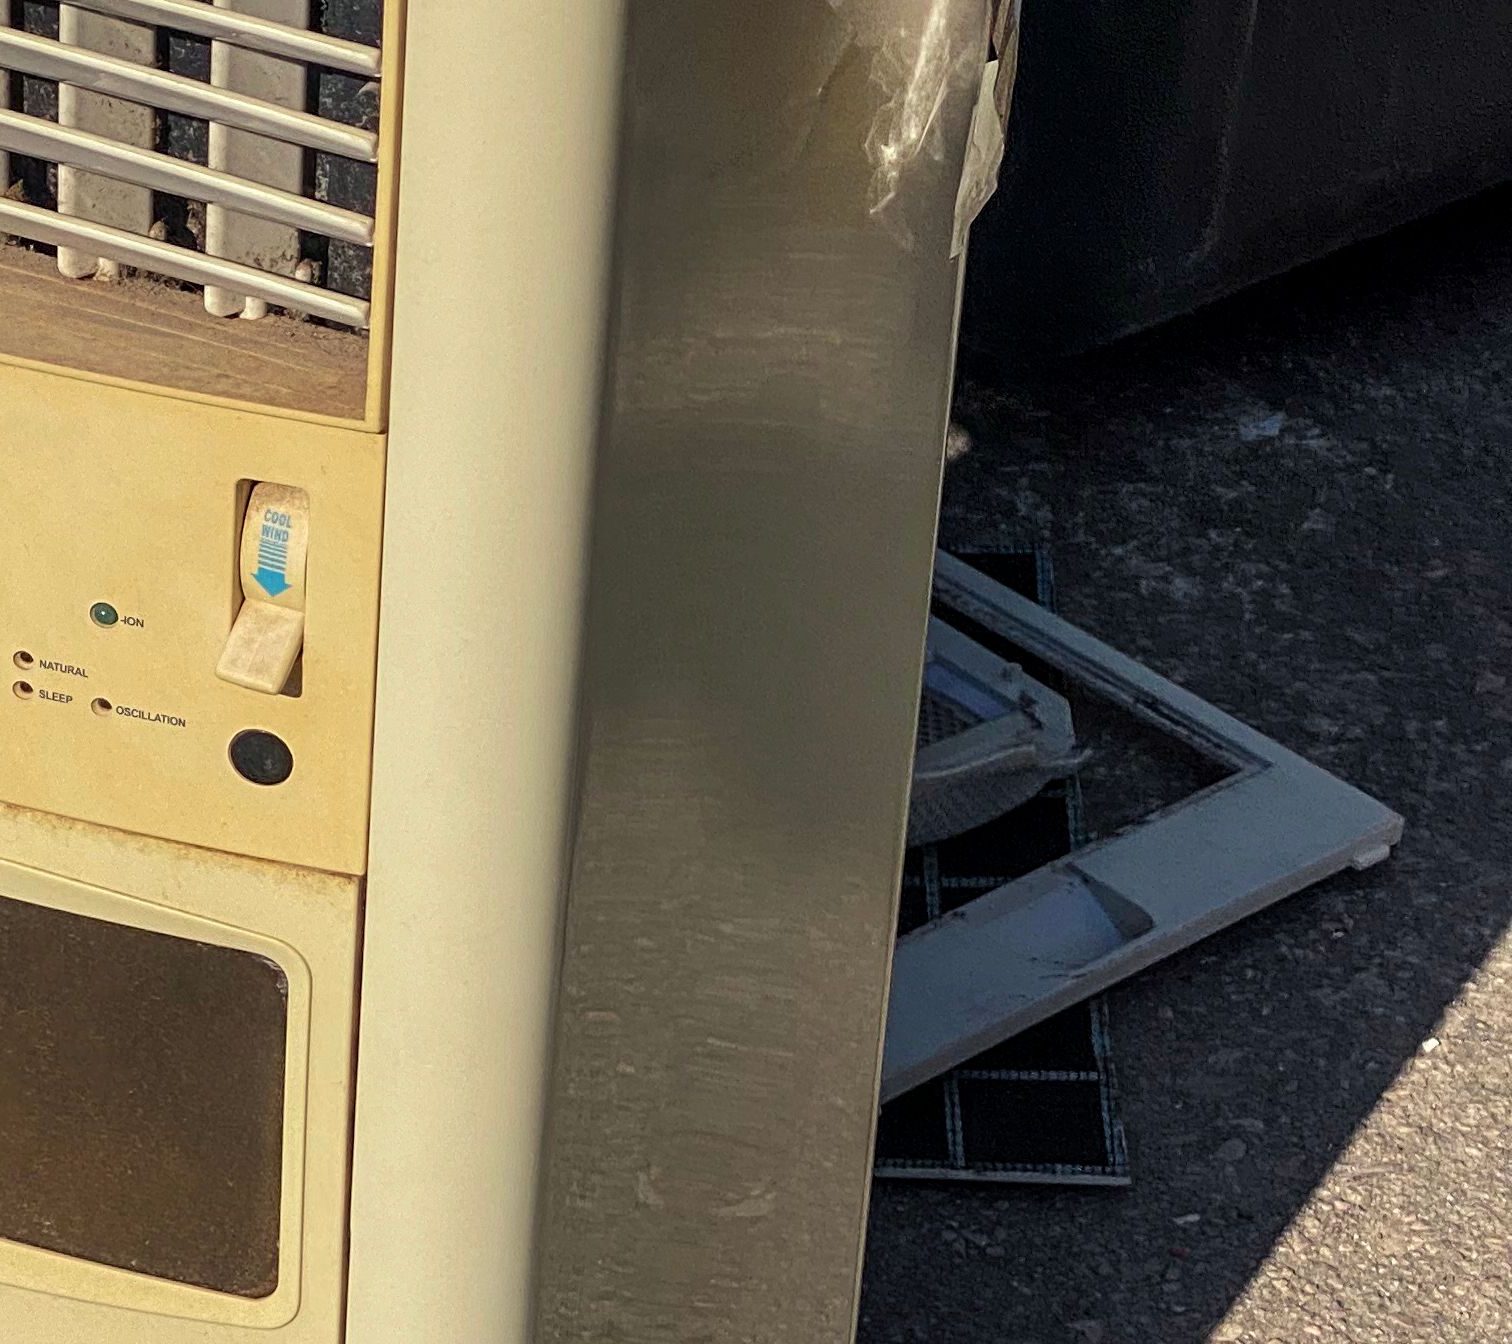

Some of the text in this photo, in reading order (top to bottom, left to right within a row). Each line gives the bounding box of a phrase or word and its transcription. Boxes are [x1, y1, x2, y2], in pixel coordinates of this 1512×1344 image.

[264, 508, 292, 529] COOL
[262, 523, 289, 543] WIND
[39, 659, 89, 679] NATURAL
[38, 689, 74, 705] SLEEP
[115, 705, 187, 728] OSCILLATION
